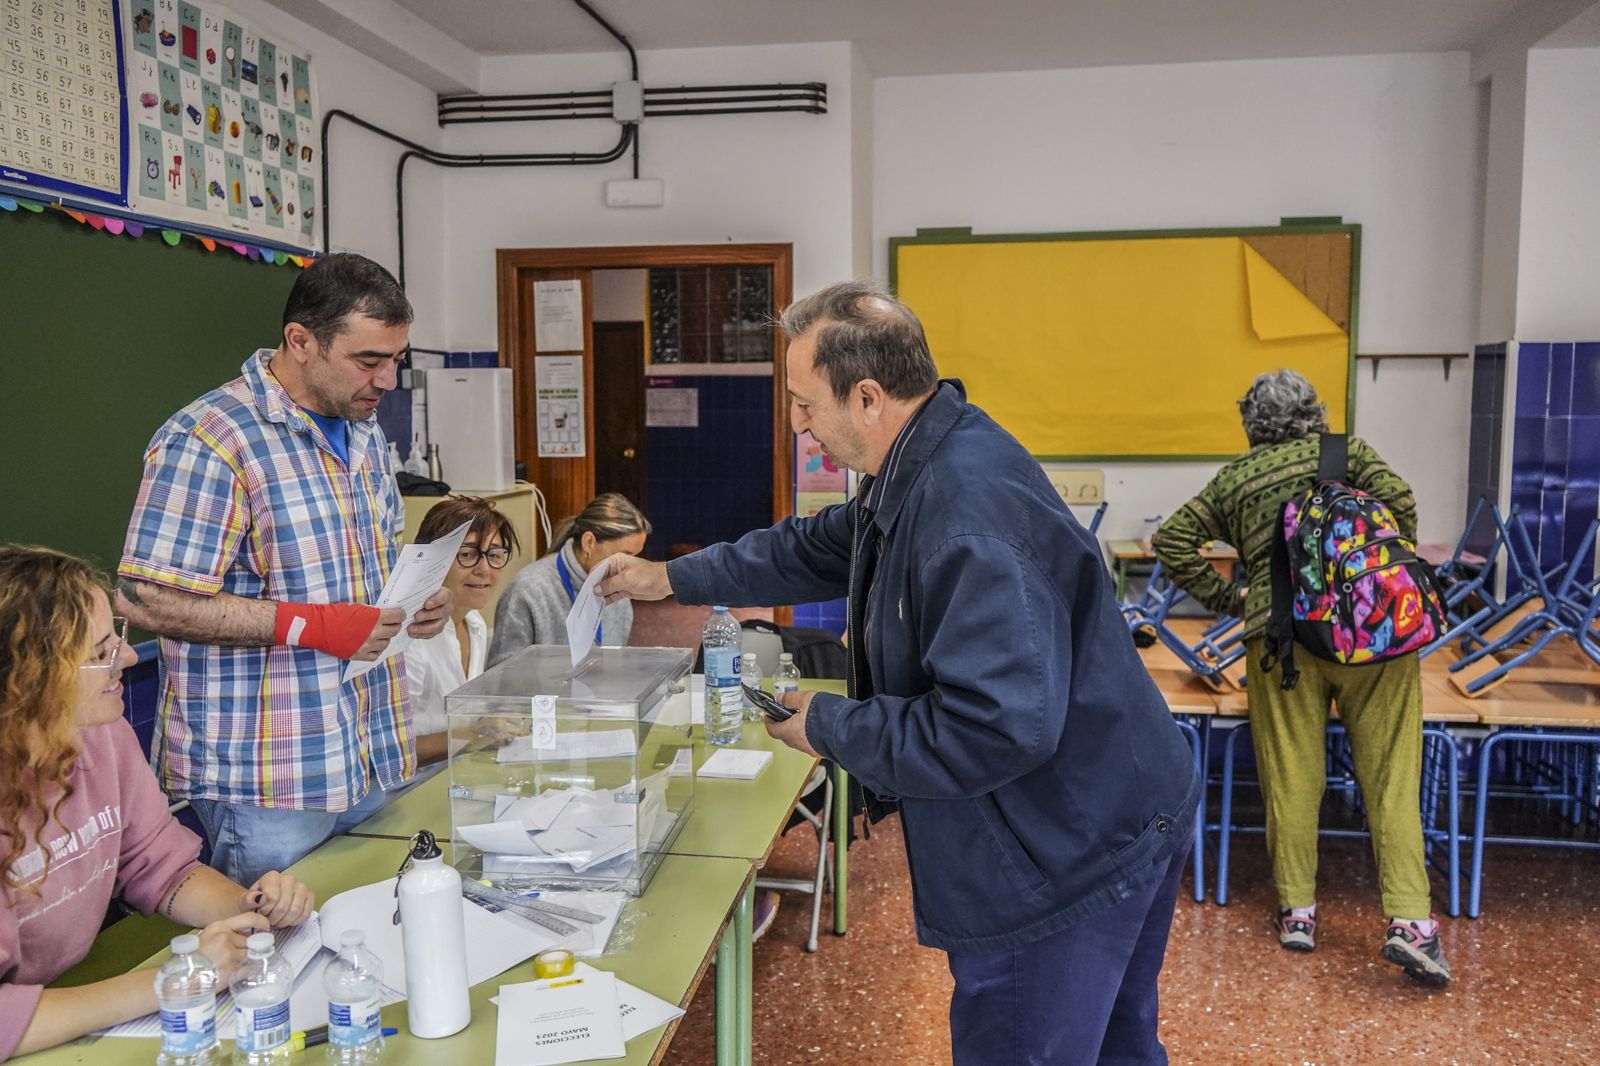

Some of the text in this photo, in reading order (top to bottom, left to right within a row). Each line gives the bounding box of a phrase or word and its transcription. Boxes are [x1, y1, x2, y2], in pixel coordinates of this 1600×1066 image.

[98, 805, 114, 830] of
[535, 1033, 590, 1046] ELECCIONES
[536, 1027, 589, 1040] MAYO 2023
